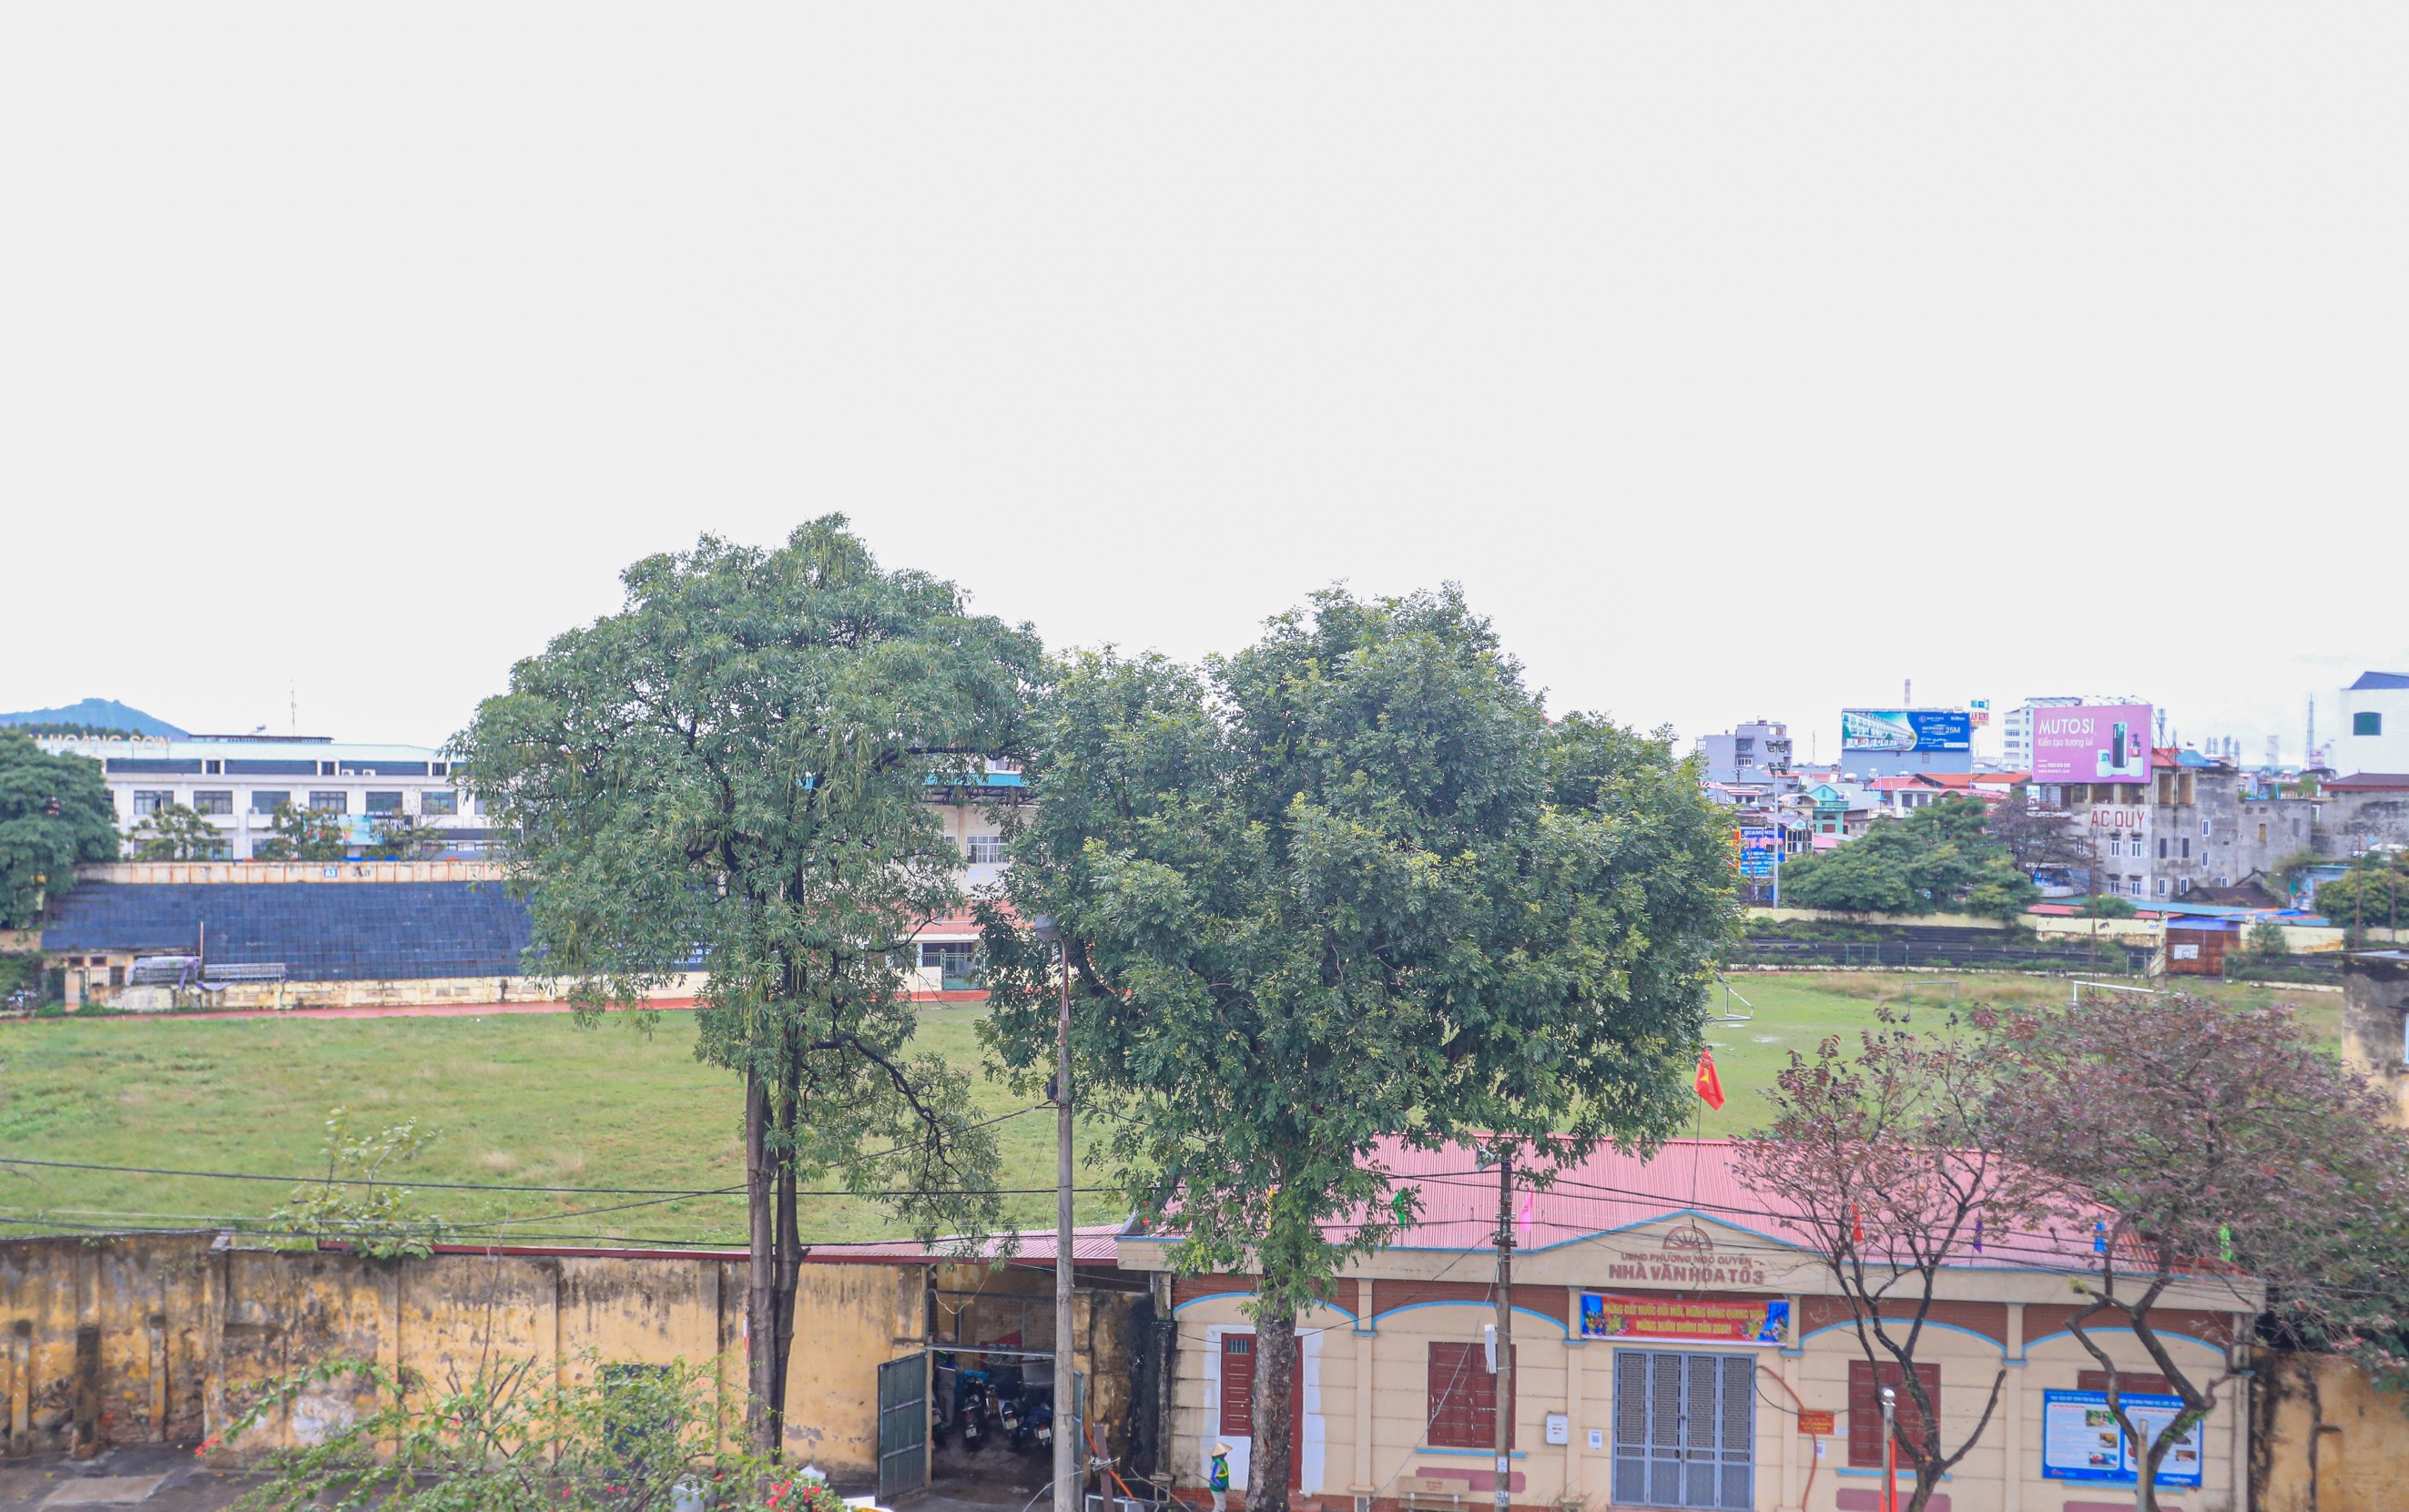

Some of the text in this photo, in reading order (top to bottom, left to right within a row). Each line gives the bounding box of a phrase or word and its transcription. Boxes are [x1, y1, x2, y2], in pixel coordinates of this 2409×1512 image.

[2038, 717, 2094, 735] MUTOSI
[48, 730, 122, 749] HOÀNG
[129, 735, 171, 749] SƠN
[2038, 736, 2052, 747] Kiến
[2114, 810, 2145, 828] QUY
[1609, 1262, 1648, 1280] NHÀ
[1651, 1263, 1688, 1282] VĂN
[1753, 1269, 1764, 1285] 3
